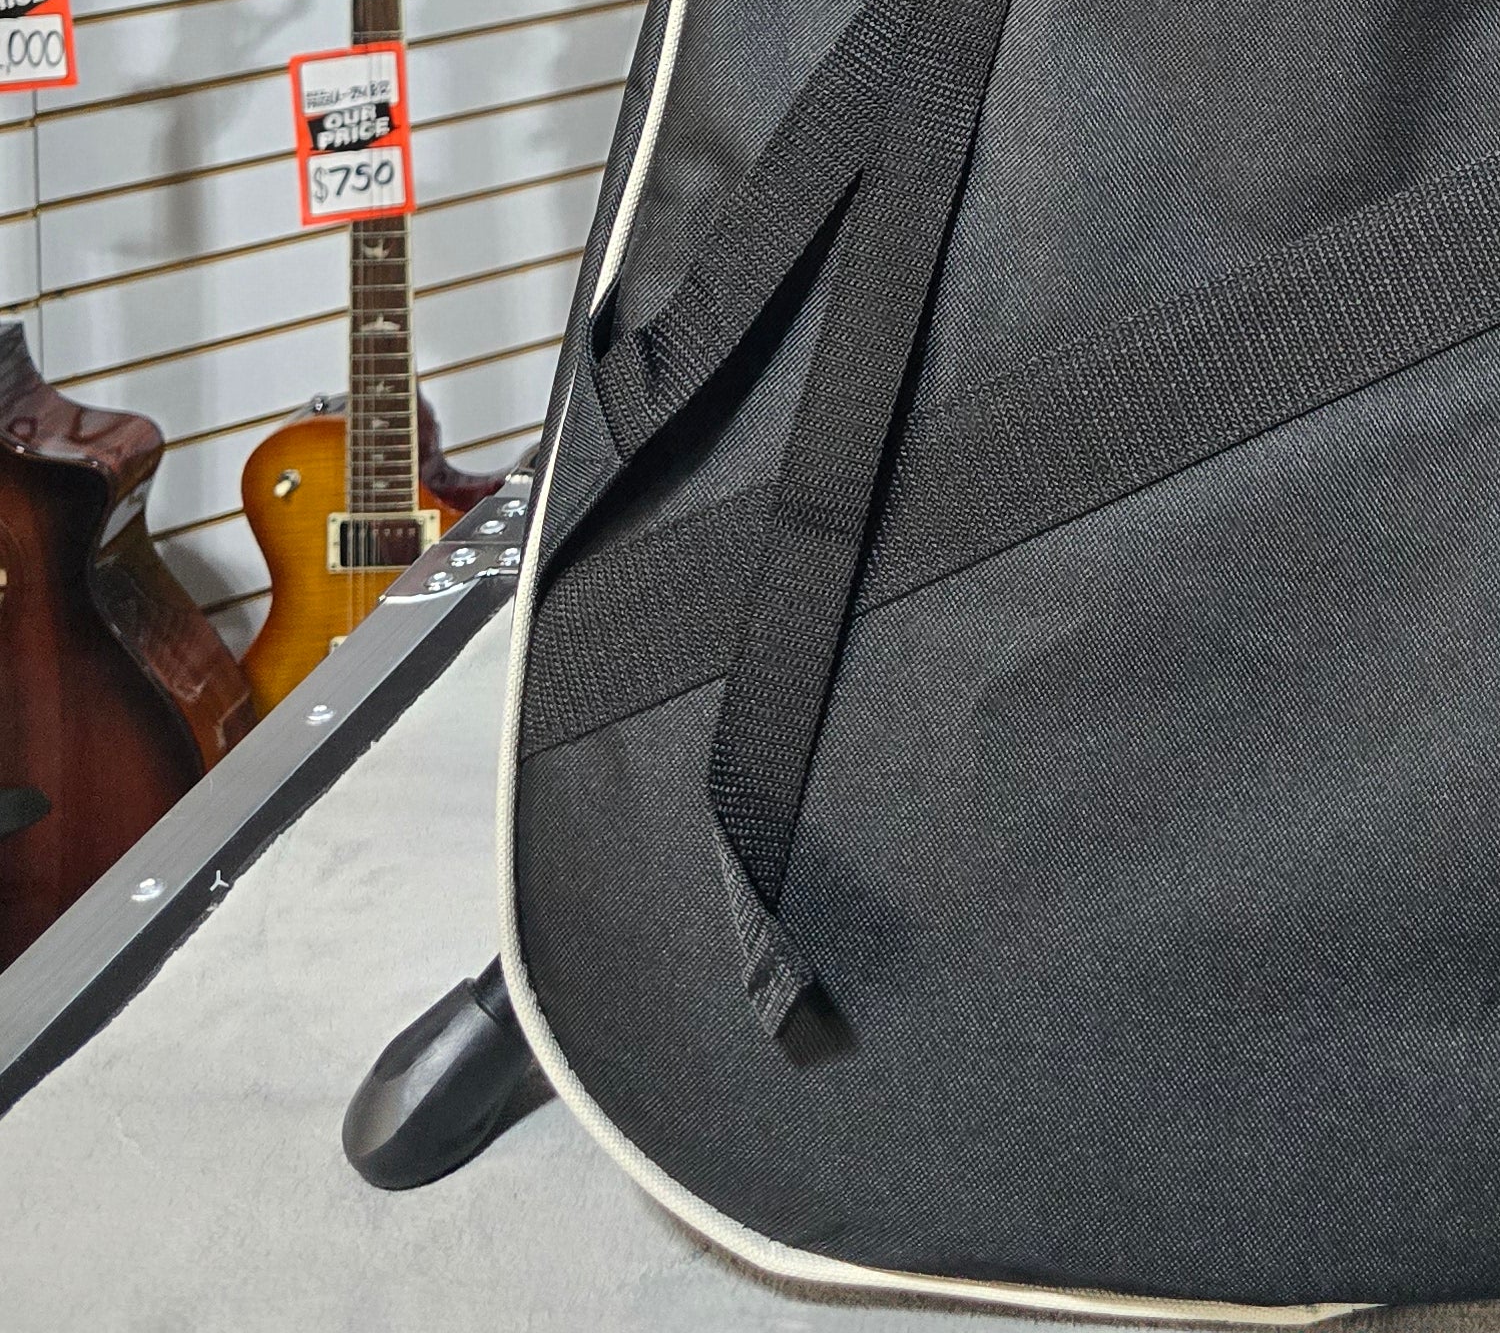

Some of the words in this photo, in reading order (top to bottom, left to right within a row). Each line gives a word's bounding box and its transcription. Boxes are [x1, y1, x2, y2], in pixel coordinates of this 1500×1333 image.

[317, 116, 390, 151] PRICE
[323, 103, 377, 131] OUR
[313, 159, 394, 206] $750
